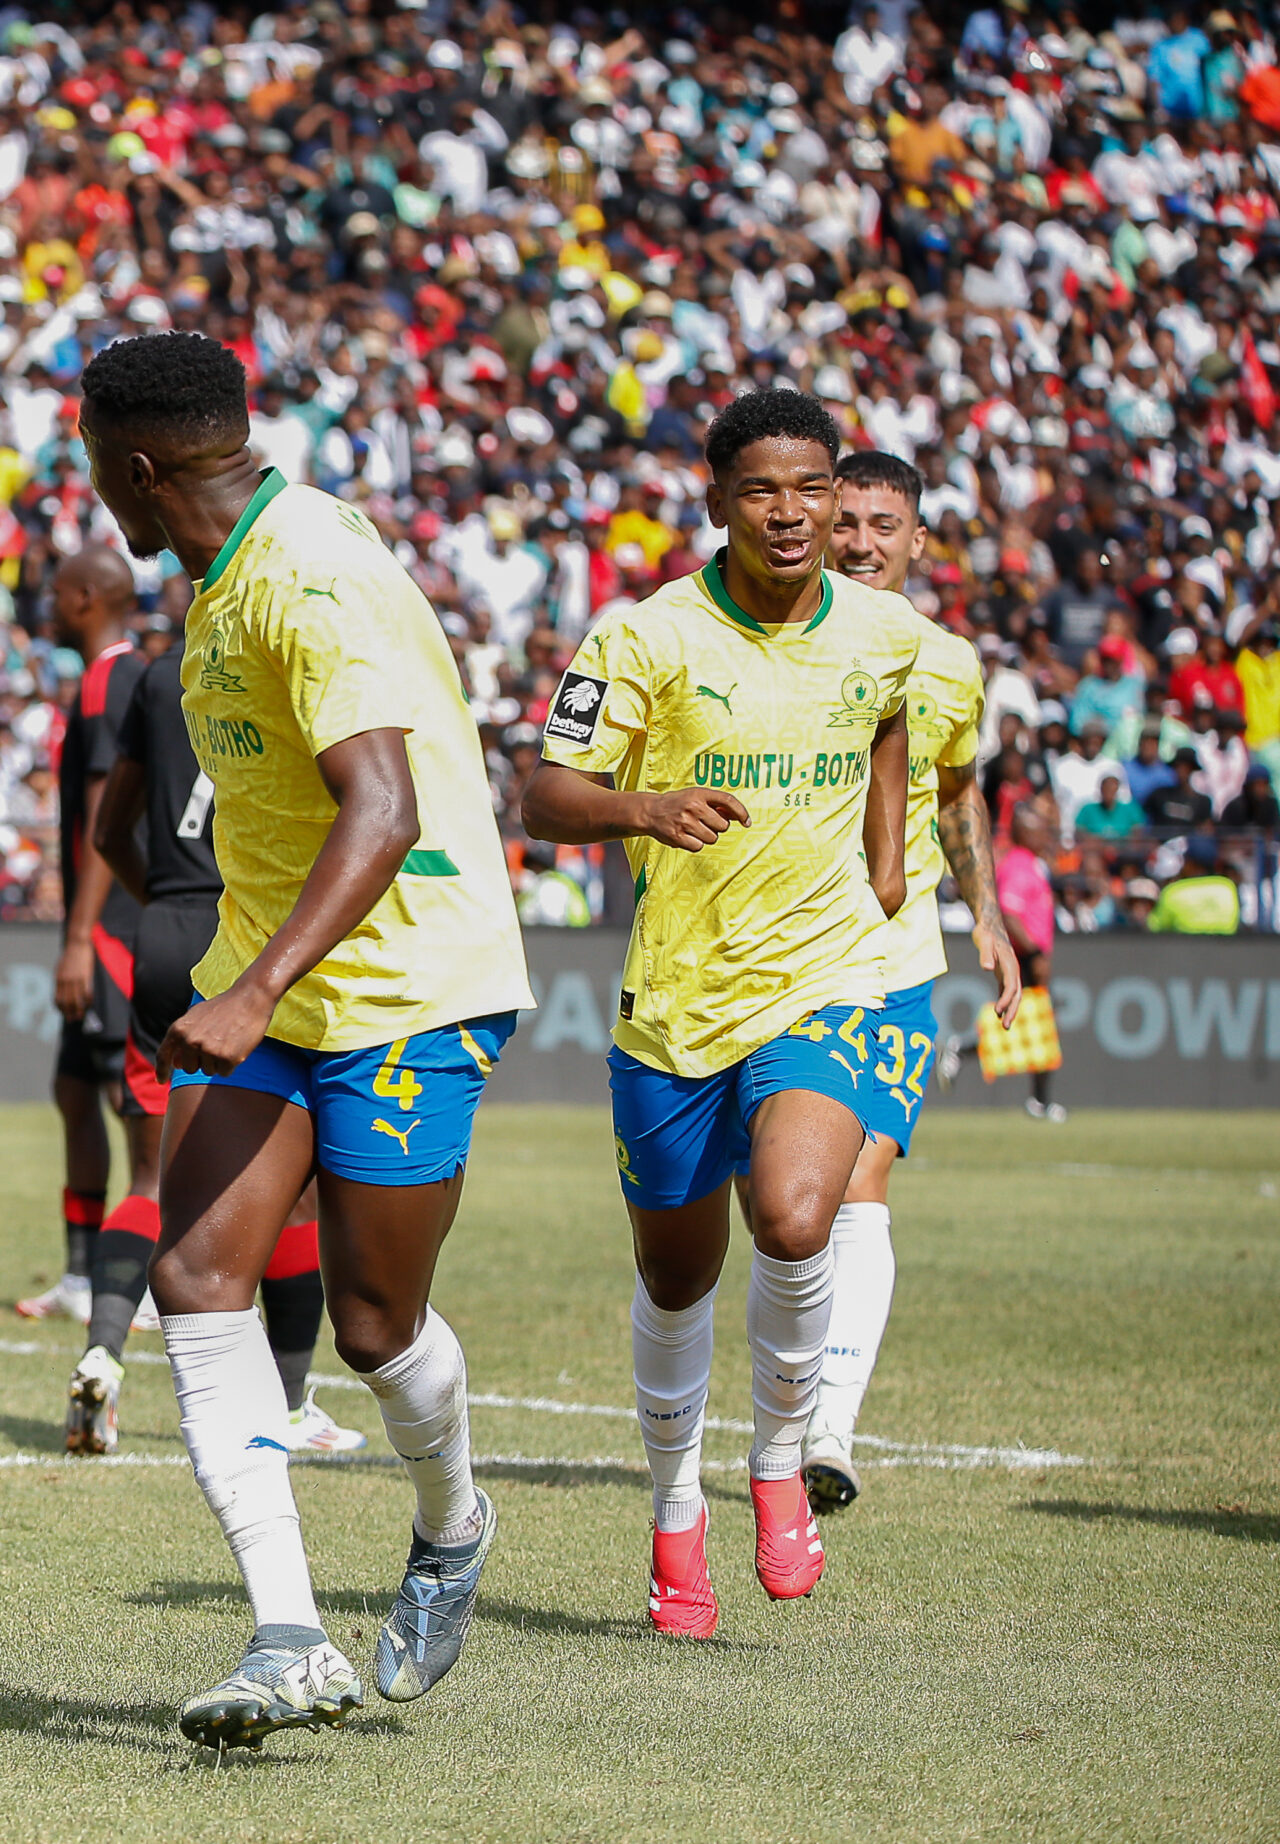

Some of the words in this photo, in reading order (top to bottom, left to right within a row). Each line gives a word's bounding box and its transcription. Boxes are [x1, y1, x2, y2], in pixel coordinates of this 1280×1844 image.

[206, 715, 264, 757] BOTHO
[551, 713, 593, 737] betway
[694, 753, 794, 788] UBUNTU
[784, 793, 791, 806] S
[804, 793, 811, 806] E
[372, 1037, 423, 1111] 4
[874, 1024, 932, 1098] 32
[645, 1404, 692, 1420] MSFC
